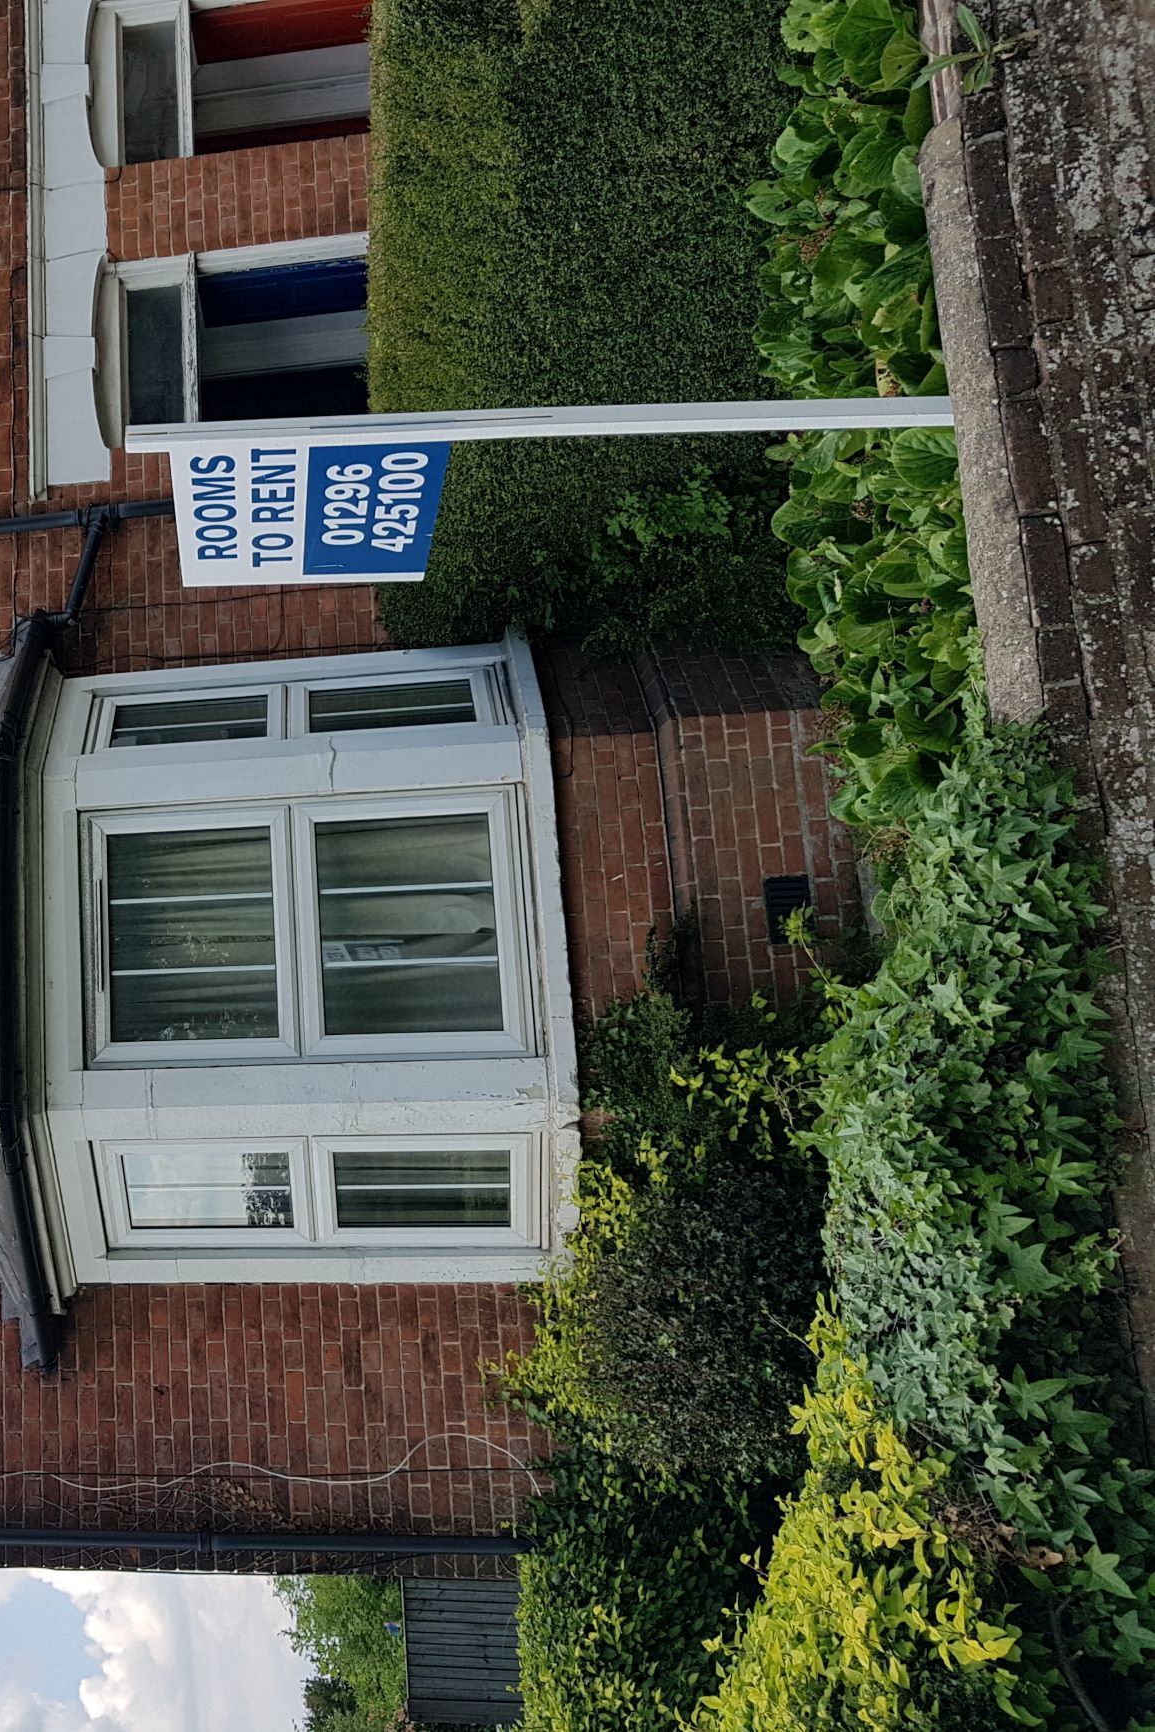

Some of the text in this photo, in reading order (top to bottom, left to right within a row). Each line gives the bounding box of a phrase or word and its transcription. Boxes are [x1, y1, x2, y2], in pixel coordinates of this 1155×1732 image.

[190, 455, 238, 560] ROOMS
[321, 463, 373, 546] 01296
[371, 452, 429, 553] 425100
[252, 533, 294, 567] TO
